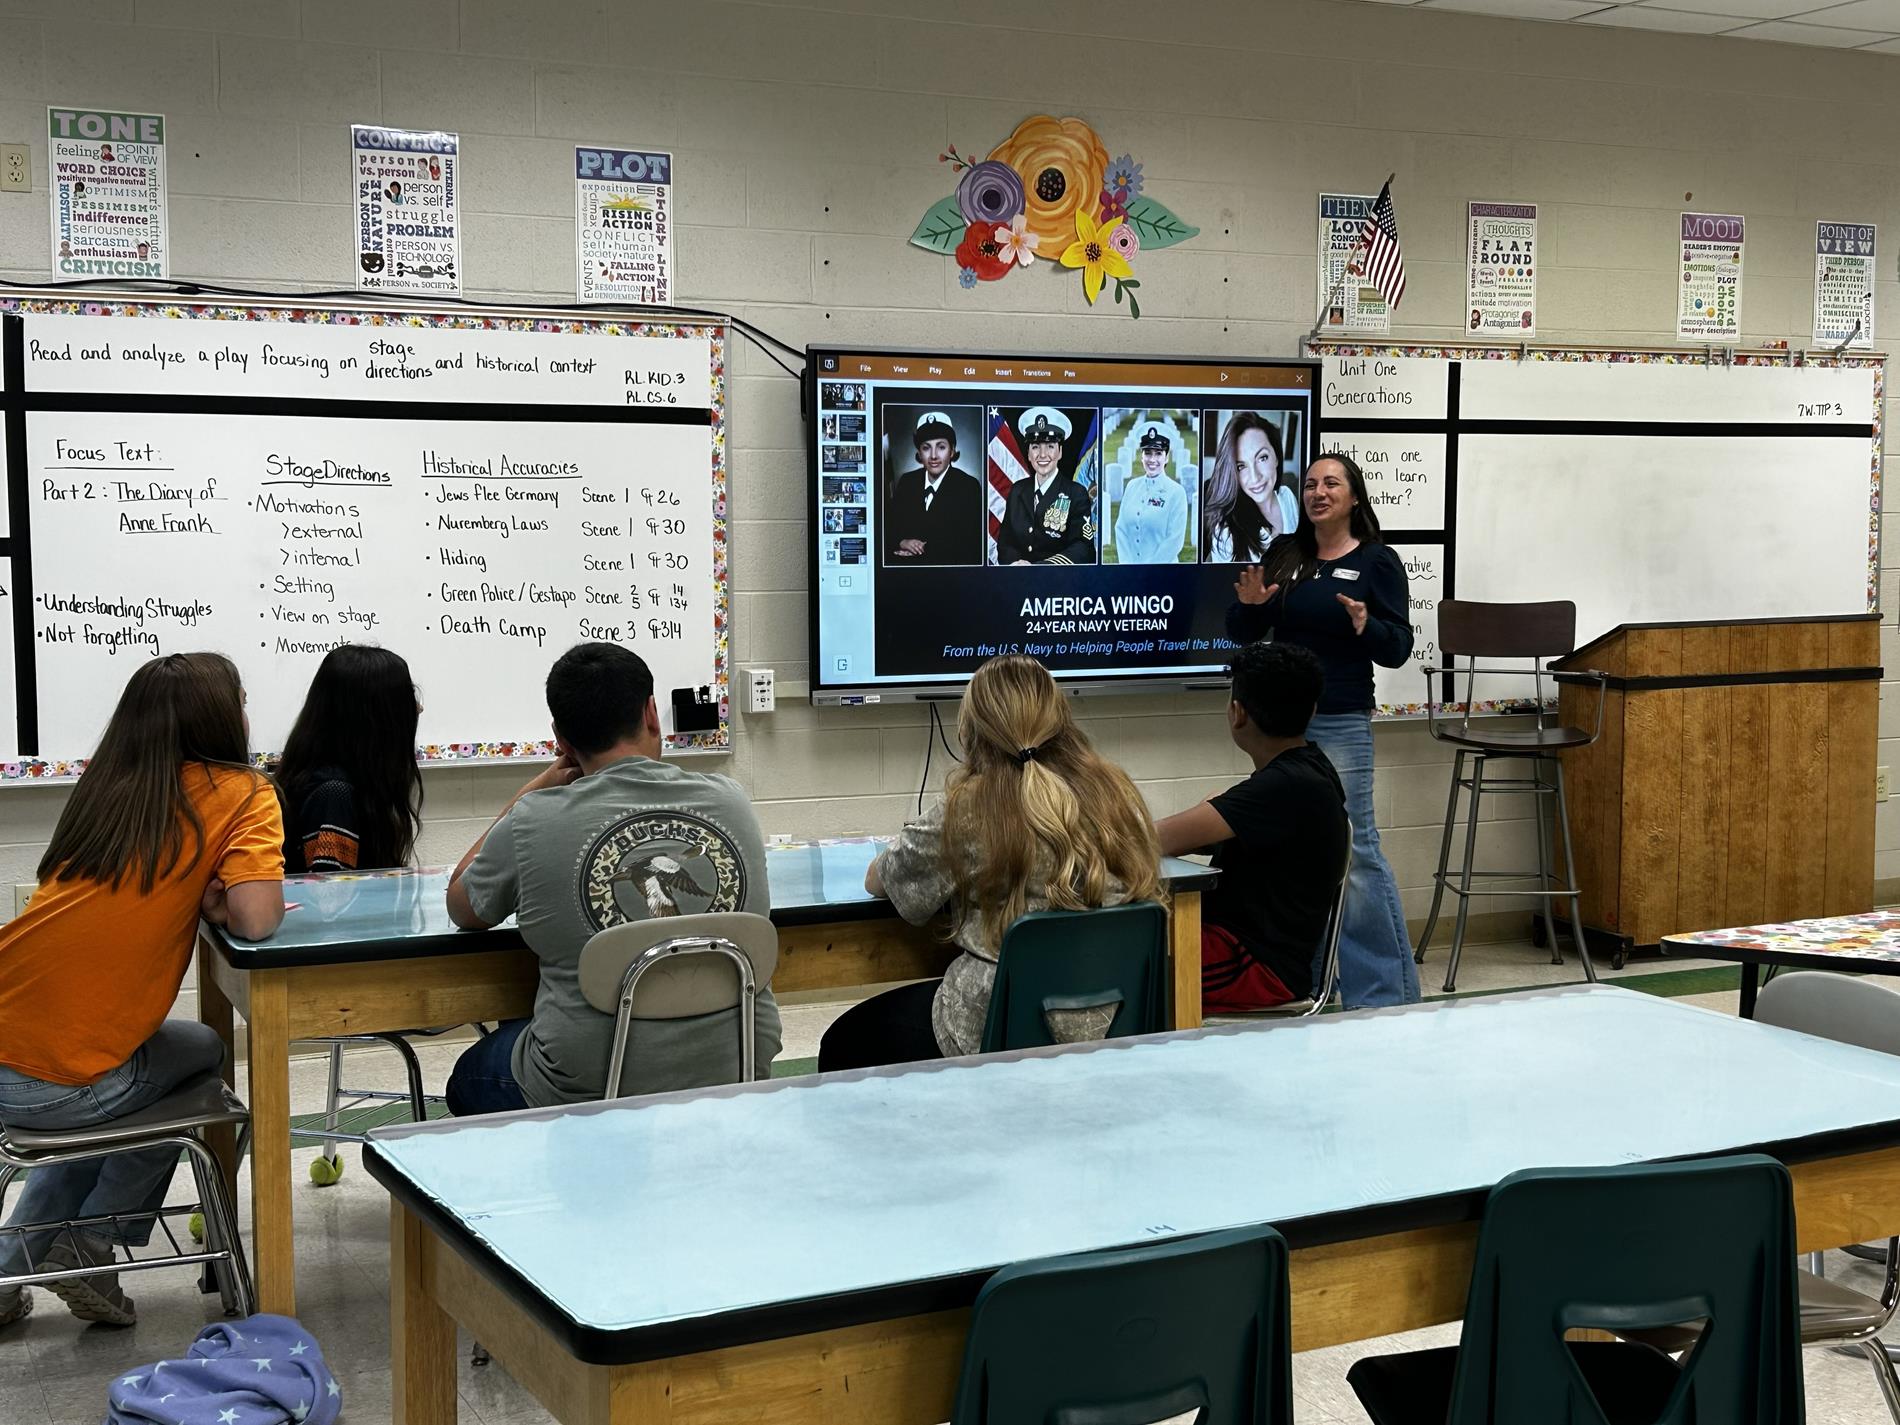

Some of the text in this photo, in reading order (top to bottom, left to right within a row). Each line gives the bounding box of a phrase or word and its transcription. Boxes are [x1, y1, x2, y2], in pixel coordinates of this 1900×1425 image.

[53, 112, 159, 142] TONE
[56, 143, 100, 160] feeling
[116, 144, 157, 155] POINT
[117, 154, 158, 165] OF VIEW
[359, 154, 415, 166] person
[579, 151, 668, 181] PLOT
[57, 163, 146, 177] WORD CHOICE
[360, 166, 415, 178] vs. person
[57, 175, 146, 186] positive negative neutral
[403, 182, 443, 194] person
[582, 183, 636, 194] exposition
[86, 187, 148, 198] OPTIMISM
[404, 194, 444, 207] vs. self
[60, 184, 72, 241] HOSTILITY
[72, 201, 148, 213] PESSIMISM
[149, 168, 163, 260] writer's attitude
[602, 209, 652, 221] RISING
[72, 211, 148, 225] indifference
[371, 180, 383, 252] NATURE
[386, 209, 454, 225] struggle
[73, 224, 149, 236] seriousness
[387, 223, 454, 238] PROBLEM
[602, 219, 653, 231] ACTION
[1486, 224, 1531, 236] THOUGHTS
[1684, 217, 1741, 239] MOOD
[1820, 225, 1874, 240] POINT OF
[73, 236, 129, 248] sarcasm
[582, 229, 655, 243] CONFLICT
[74, 248, 137, 259] enthusiasm
[395, 241, 454, 252] PERSON VS.
[615, 242, 655, 252] human
[1331, 242, 1349, 250] ALL
[1481, 239, 1533, 252] FLAT
[1820, 239, 1872, 254] VIEW
[396, 251, 454, 264] TECHNOLOGY
[623, 251, 655, 261] nature
[1480, 253, 1533, 265] ROUND
[60, 259, 161, 277] CRITICISM
[610, 261, 655, 271] FALLING
[584, 260, 593, 299] EVENTS
[616, 272, 655, 282] ACTION
[1717, 276, 1737, 285] PLOT
[1717, 285, 1727, 326] choice
[1727, 286, 1737, 326] word
[30, 339, 358, 378] Read and analyze a play focusing on
[369, 339, 416, 363] stage
[435, 352, 597, 374] and historical context
[859, 364, 872, 373] File
[893, 366, 909, 374] View
[929, 366, 943, 375] Play
[964, 367, 976, 375] Edit
[995, 368, 1012, 377] Insert
[1023, 369, 1051, 377] Transitions
[1339, 359, 1398, 376] Unit One
[365, 364, 433, 380] directions
[1326, 382, 1413, 406] Generations
[56, 439, 106, 461] Focus
[1365, 450, 1389, 463] can
[1401, 450, 1422, 462] one
[422, 450, 579, 476] Historical Accuracies
[1395, 468, 1427, 483] learn
[43, 478, 79, 501] Part
[110, 481, 145, 501] The
[149, 482, 193, 508] Diary
[199, 478, 217, 500] of
[436, 484, 469, 503] Jews
[505, 487, 559, 508] Germany
[582, 487, 616, 503] Scene
[256, 493, 360, 517] Motivations
[119, 512, 213, 533] Anne Frank
[438, 515, 549, 539] Nuremberg Laws
[581, 521, 622, 537] Scene
[440, 548, 487, 573] Hiding
[583, 554, 624, 571] Scene
[273, 575, 335, 602] Setting
[441, 583, 577, 609] Green Police Gestapo
[585, 584, 623, 604] Scene
[44, 593, 213, 627] Understanding Struggles
[1020, 595, 1174, 617] AMERICA WINGO
[271, 604, 380, 630] View on stage
[440, 614, 547, 647] Death Camp
[579, 618, 636, 642] Scene 3
[1026, 618, 1168, 634] 24-YEAR NAVY VETERAN
[46, 623, 160, 656] Not forgetting
[943, 645, 974, 657] From
[977, 643, 996, 656] the
[1024, 642, 1053, 657] Navy
[1055, 643, 1068, 654] to
[1069, 640, 1112, 656] Helping
[1116, 639, 1154, 654] People
[1157, 637, 1191, 651] Travel
[1192, 637, 1210, 650] the
[614, 823, 702, 851] DUCKS
